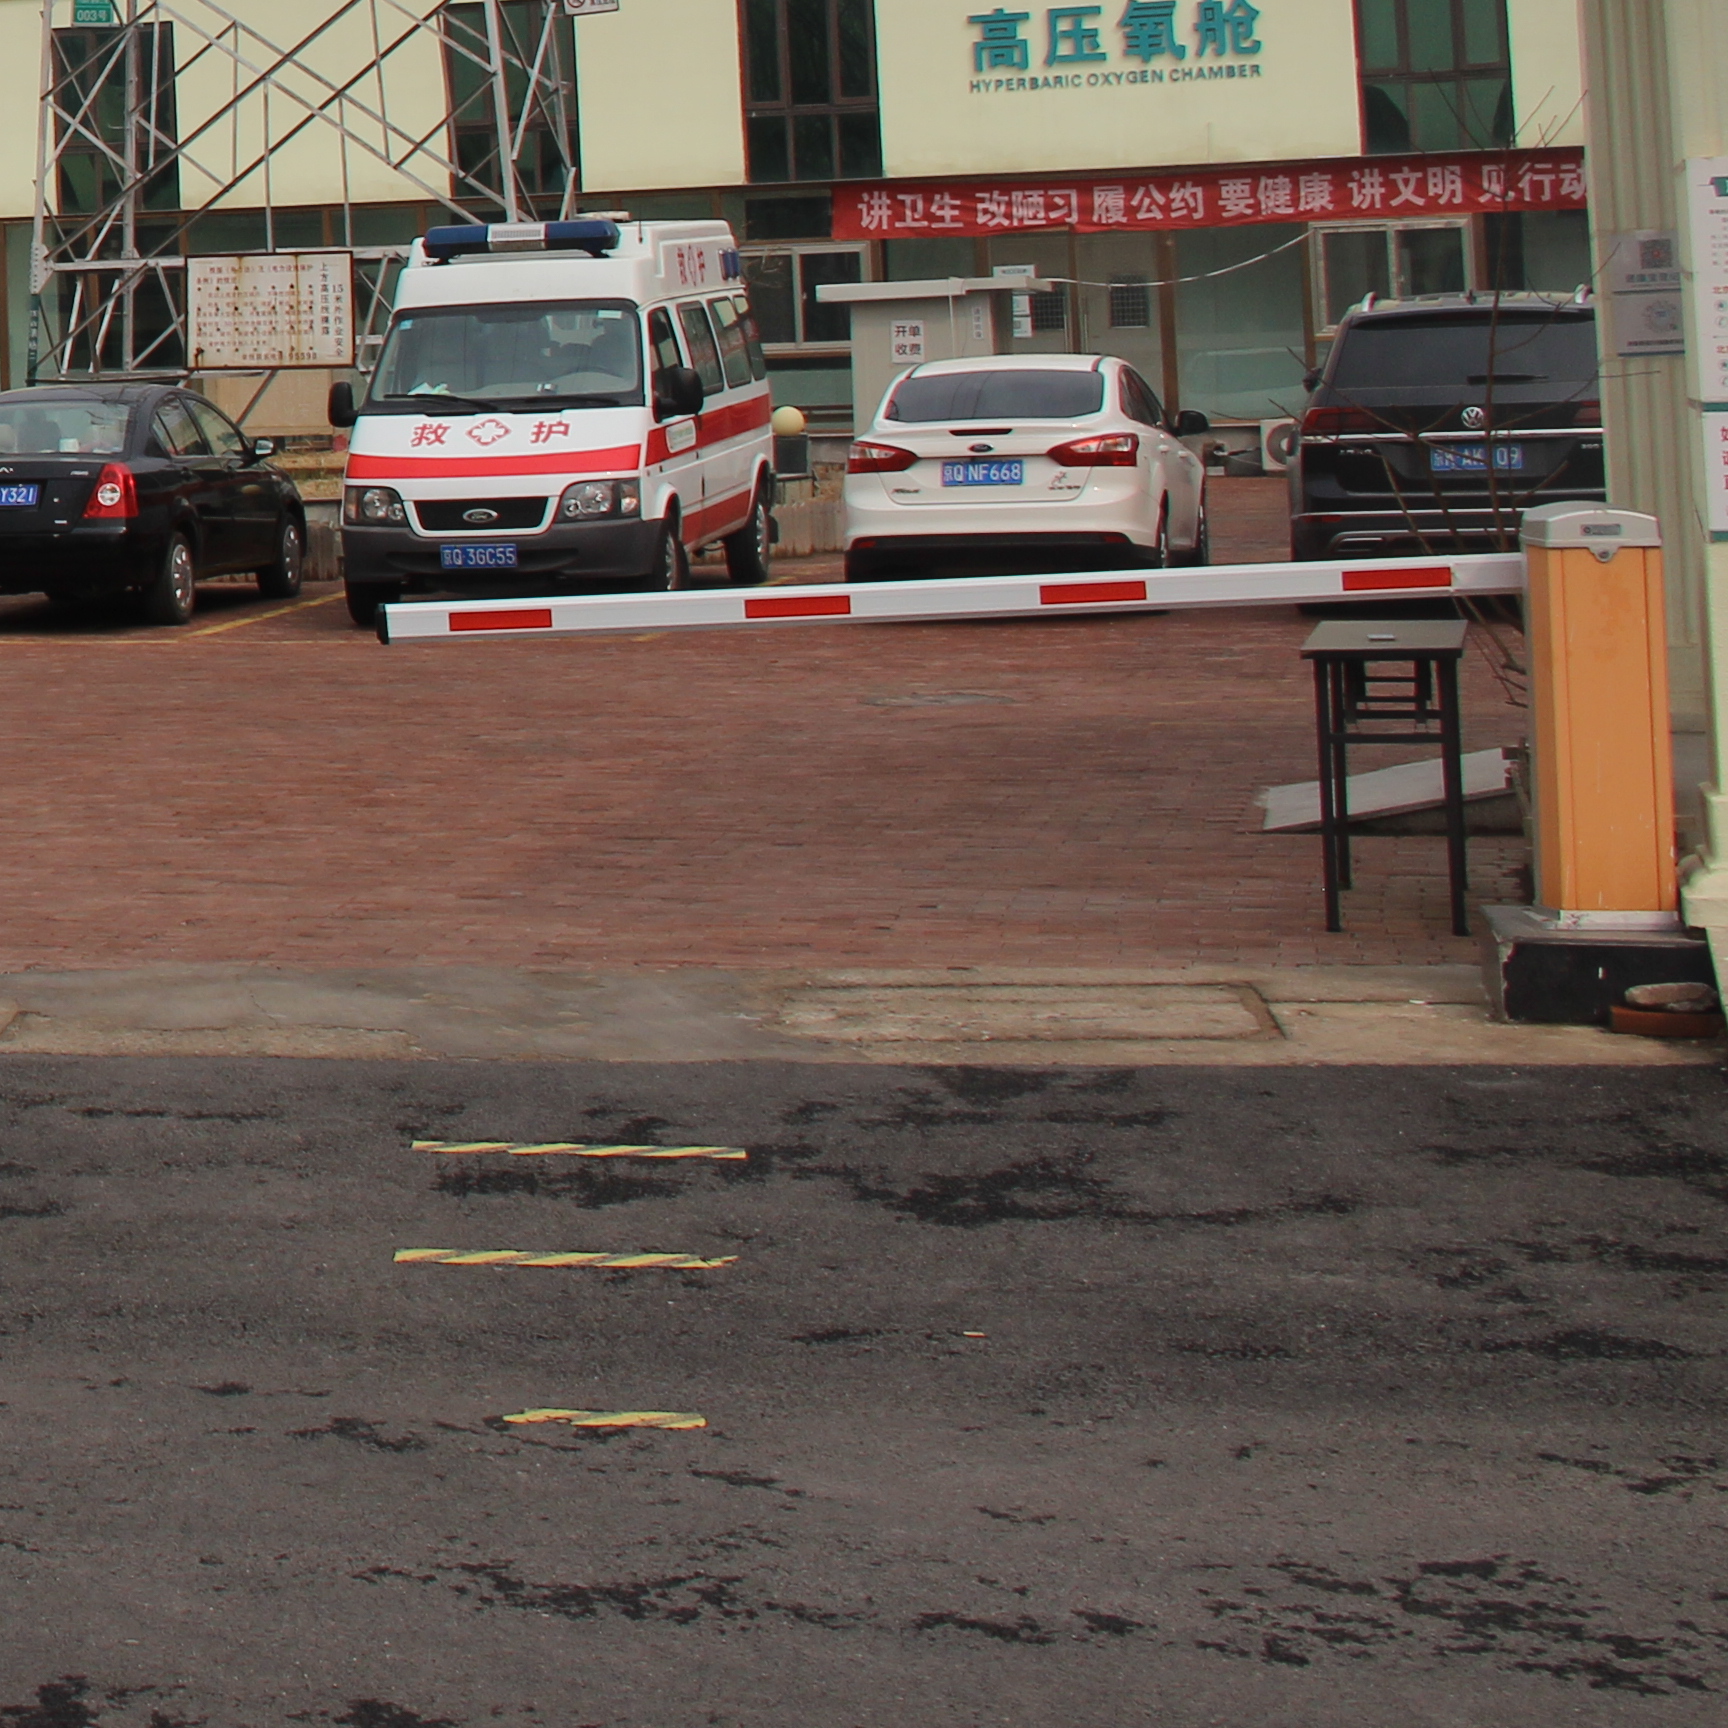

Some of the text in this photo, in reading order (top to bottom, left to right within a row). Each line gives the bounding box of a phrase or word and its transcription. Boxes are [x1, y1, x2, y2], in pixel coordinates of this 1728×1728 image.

[968, 62, 1262, 94] HYPERBARIC OXYGEN CHAMBER
[856, 191, 964, 226] 讲卫生
[973, 188, 1079, 226] 改陋习
[1092, 181, 1206, 222] 履公约
[1218, 173, 1334, 217] 要健康
[1347, 165, 1464, 209] 讲文明
[894, 324, 922, 338] 开单
[894, 342, 922, 356] 收费
[410, 419, 571, 448] 救护
